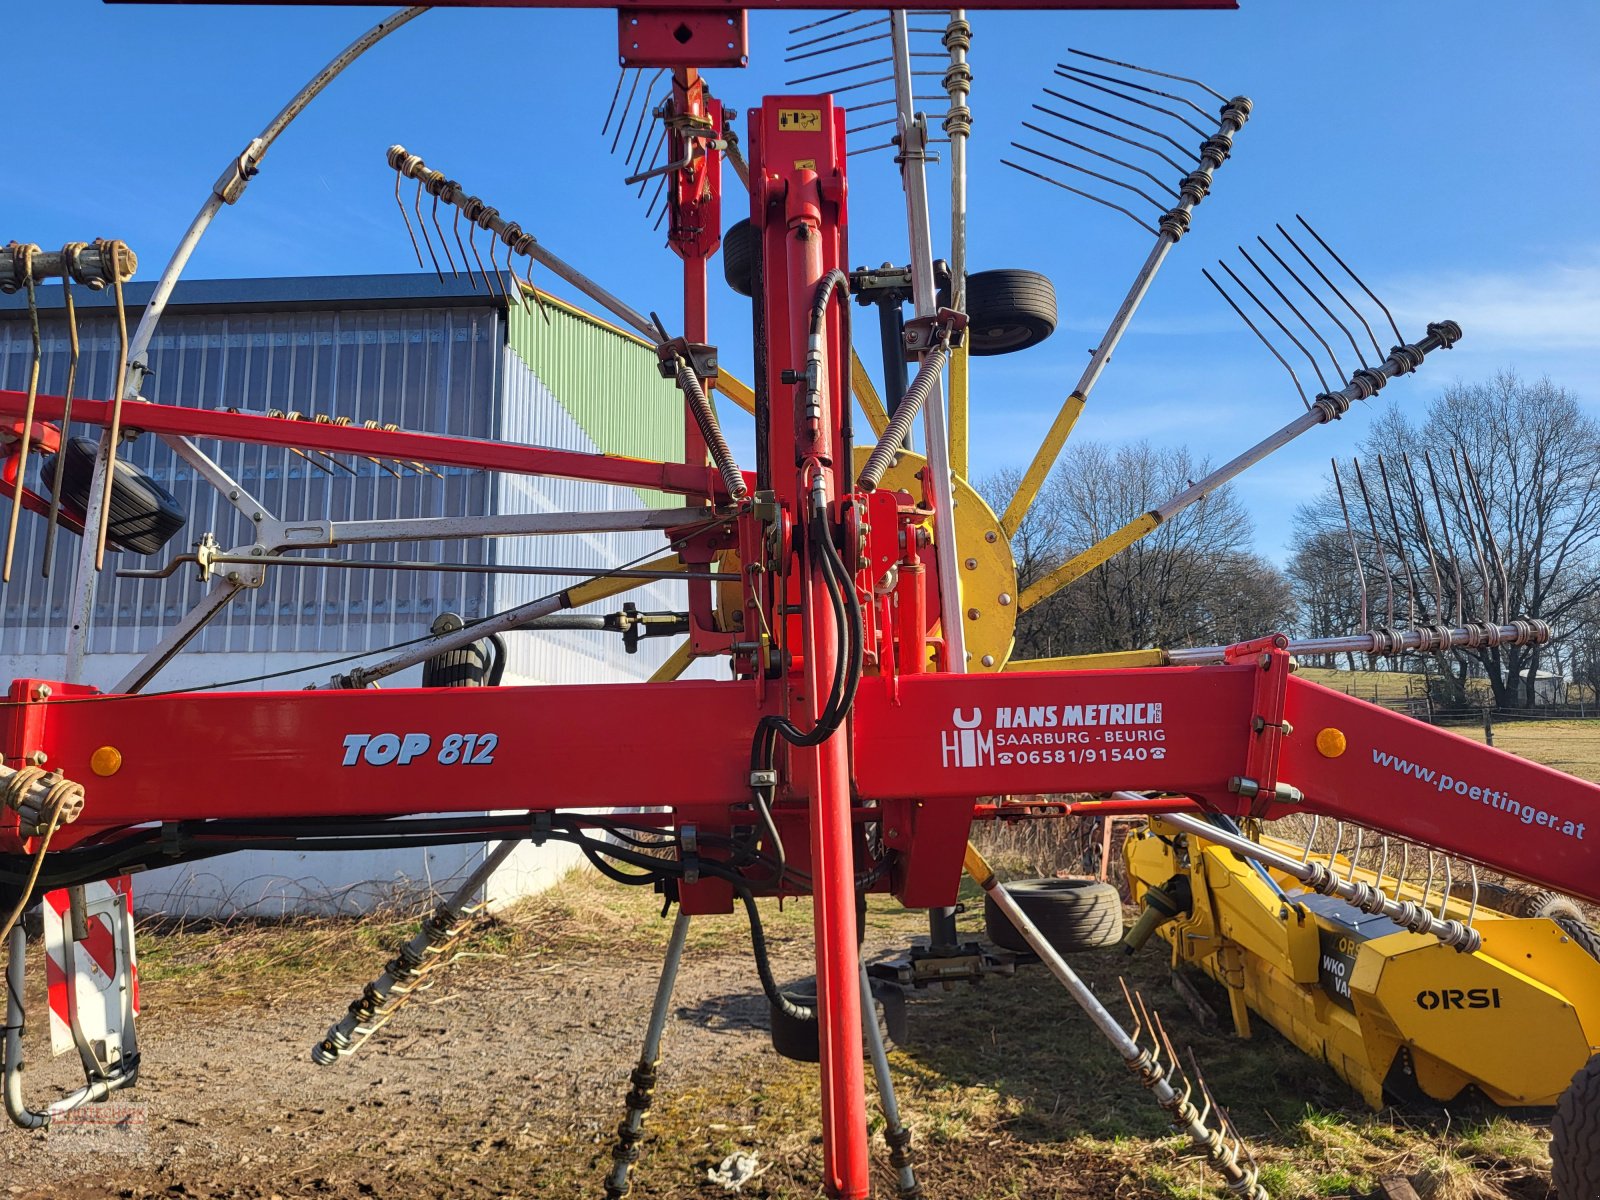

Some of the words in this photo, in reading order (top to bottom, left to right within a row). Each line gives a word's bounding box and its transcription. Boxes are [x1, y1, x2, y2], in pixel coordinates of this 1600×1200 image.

[996, 706, 1058, 728] HANS
[996, 731, 1090, 746] SAARBURG
[1105, 729, 1166, 743] BEURIG
[342, 733, 432, 766] TOP
[437, 733, 498, 765] 812
[1016, 747, 1148, 765] 06581/91540
[1372, 748, 1586, 840] www.poettinger.at
[1323, 955, 1345, 977] WKO
[1416, 988, 1501, 1010] ORSI
